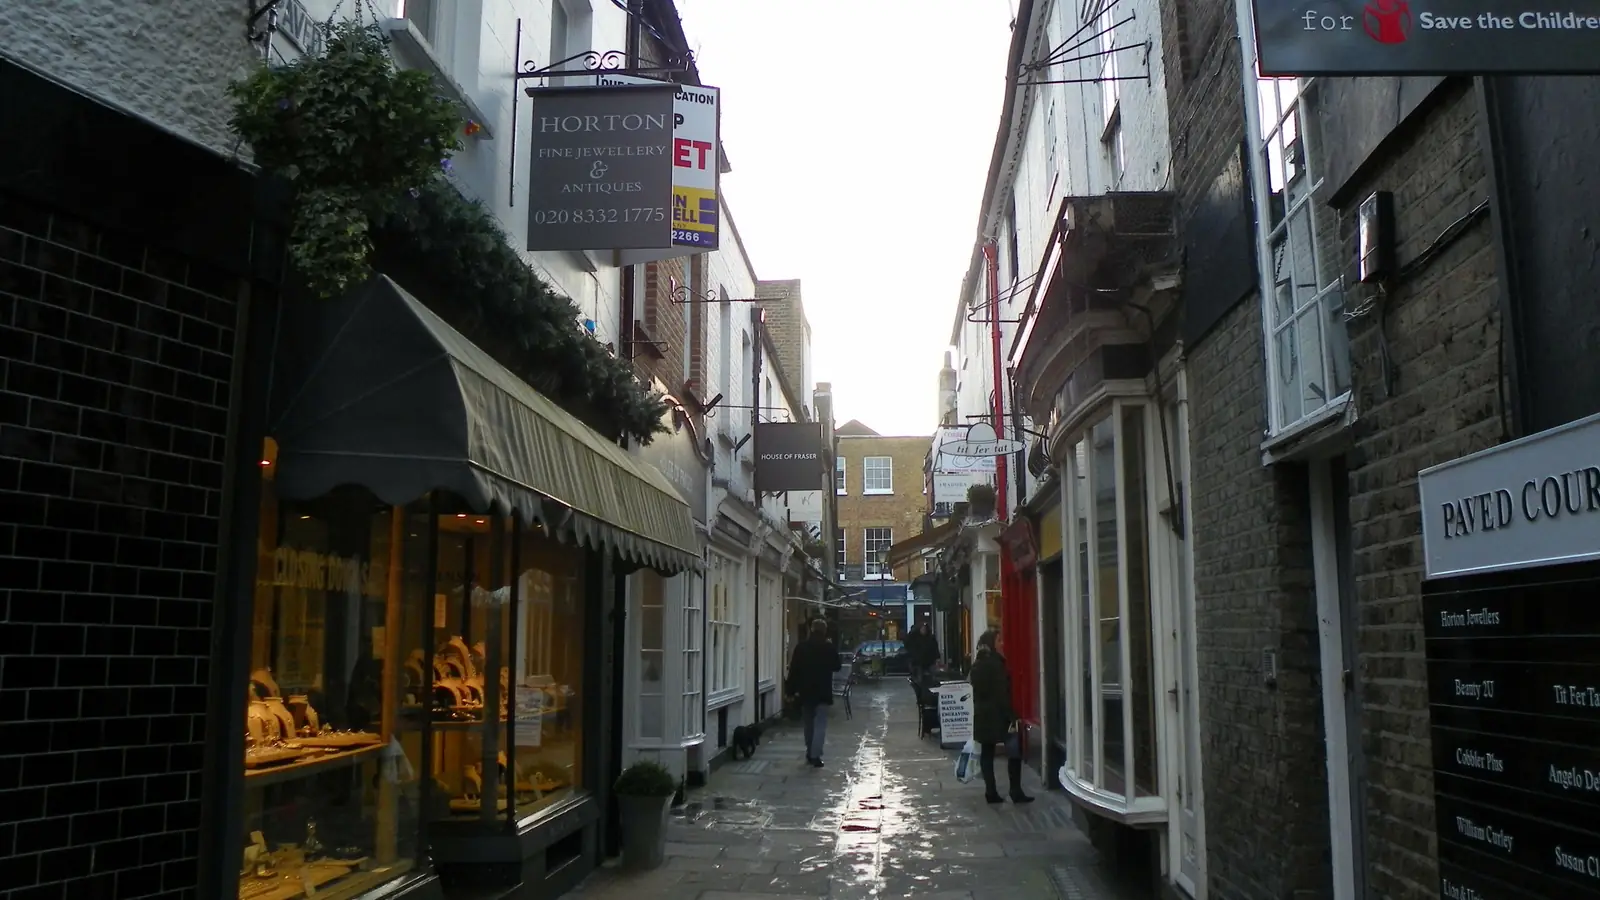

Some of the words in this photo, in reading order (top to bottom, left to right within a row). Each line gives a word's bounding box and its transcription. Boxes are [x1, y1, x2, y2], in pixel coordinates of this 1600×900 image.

[1301, 10, 1354, 31] for
[1419, 11, 1472, 30] Save
[1476, 11, 1514, 30] the
[1518, 11, 1600, 30] Childre
[540, 113, 667, 133] HORTON
[538, 147, 573, 158] FINE
[575, 145, 667, 159] JEWELLERY
[589, 160, 609, 179] &
[561, 182, 643, 194] ANTIQUES
[535, 209, 569, 224] 020
[572, 208, 618, 224] 8332
[624, 207, 665, 223] 1775
[956, 444, 969, 453] tit
[974, 444, 990, 455] fer
[994, 444, 1008, 453] tat
[1441, 488, 1513, 539] PAVED
[1440, 610, 1465, 627] Horton
[1466, 607, 1501, 626] Jewellers
[1454, 678, 1482, 700] Beauty
[1553, 684, 1568, 705] Tit
[1568, 685, 1586, 706] Fer
[1456, 747, 1486, 769] Cobbler
[1486, 752, 1505, 773] Plus
[1548, 764, 1583, 790] Angelo
[1456, 815, 1486, 841] William
[1486, 825, 1515, 853] Curley
[1554, 843, 1586, 875] Susan
